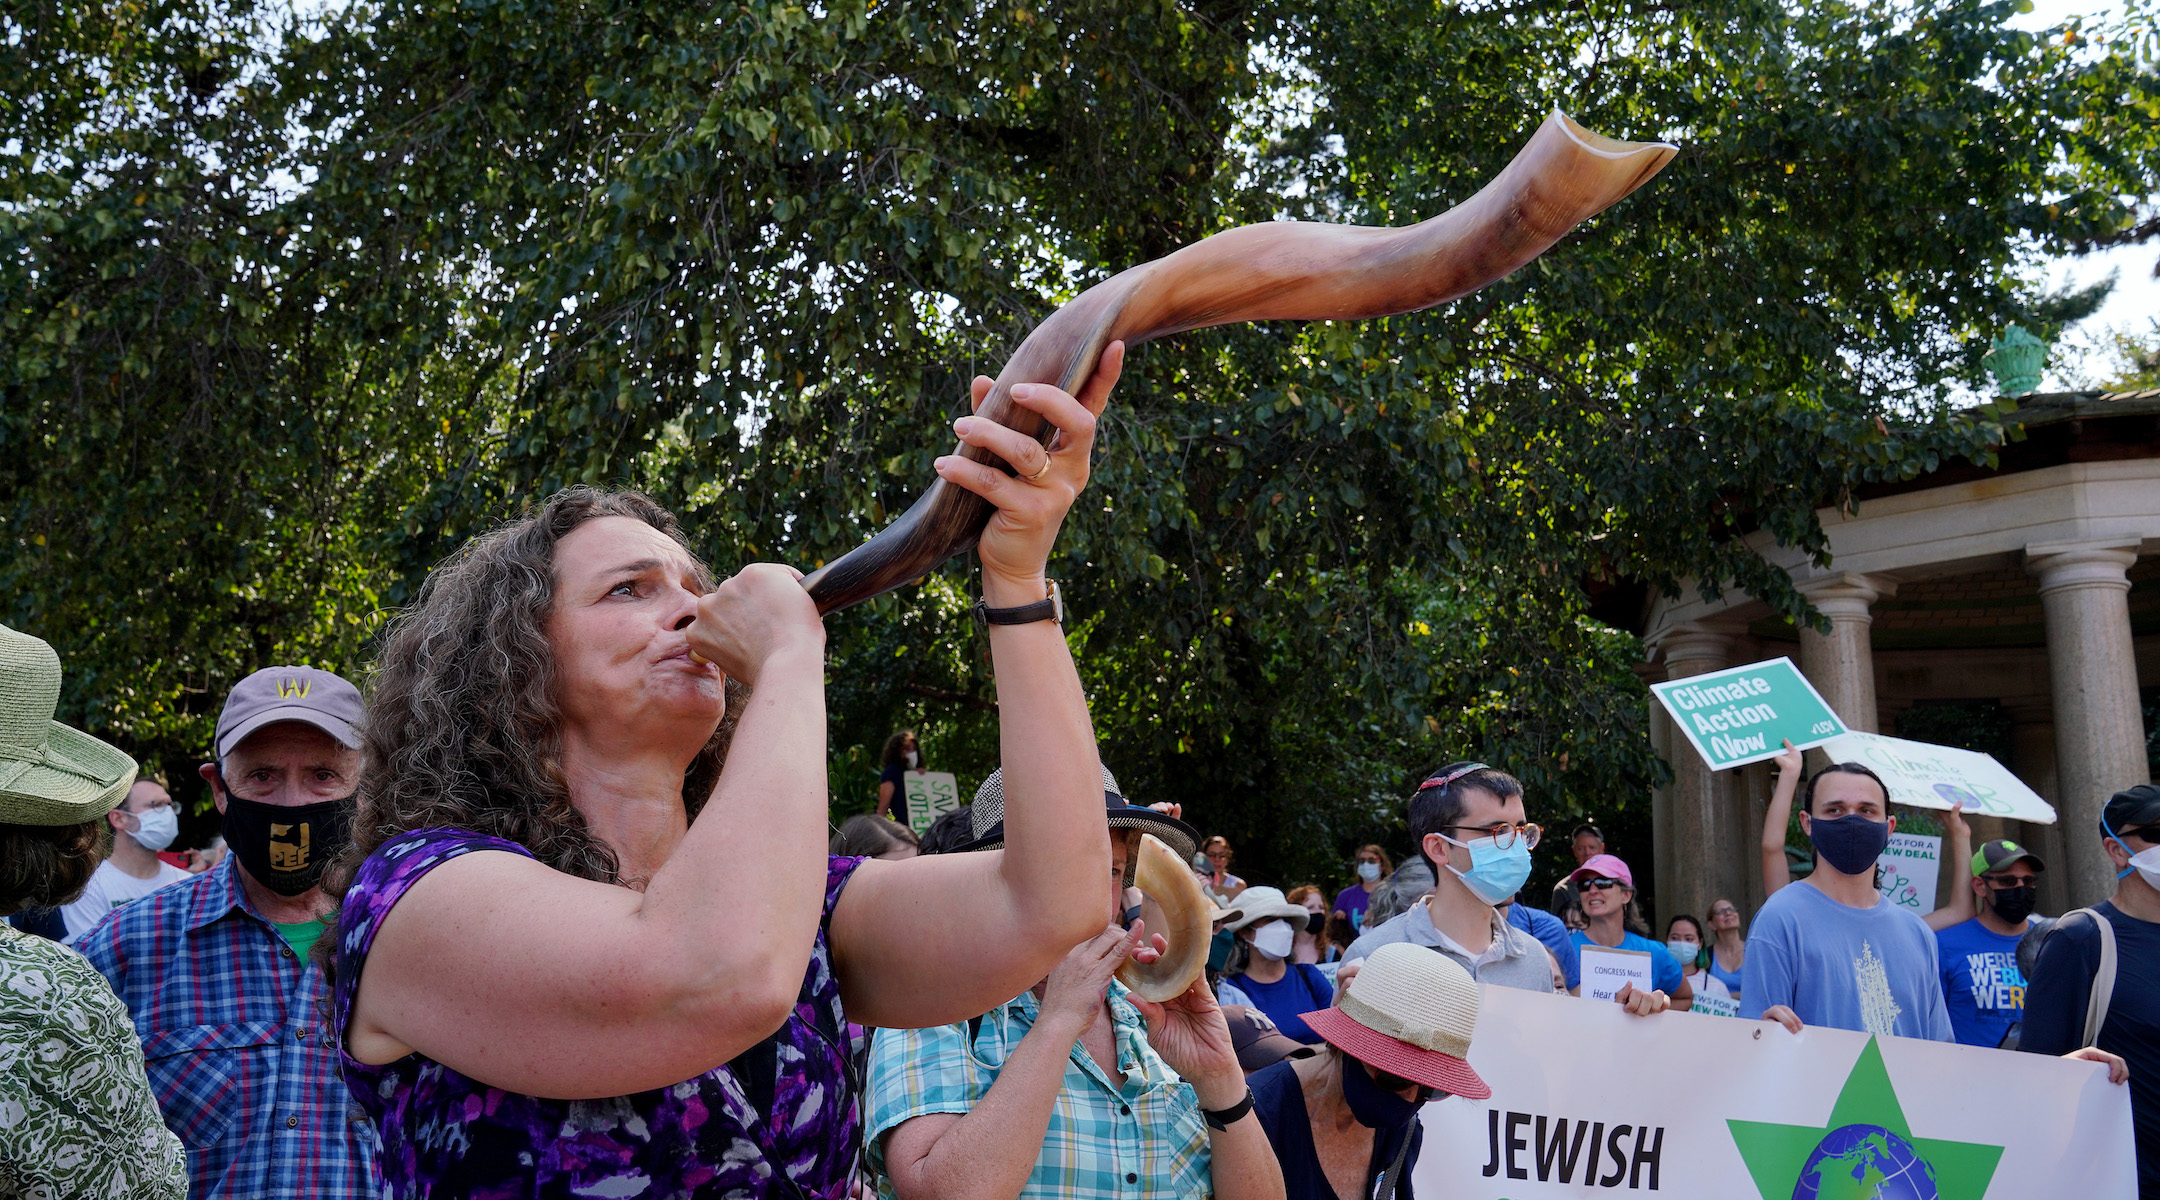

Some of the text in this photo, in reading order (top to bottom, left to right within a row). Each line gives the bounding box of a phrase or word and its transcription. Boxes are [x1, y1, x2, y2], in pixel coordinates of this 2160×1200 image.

[1671, 677, 1771, 711] Climate
[1691, 703, 1778, 735] Action
[1711, 732, 1767, 760] Now
[931, 781, 953, 819] SAV
[1904, 839, 1924, 848] FOR
[271, 849, 310, 867] PEF
[1905, 849, 1936, 860] DEAL
[1966, 952, 2018, 969] WERE
[1594, 966, 1642, 978] CONGRESS Must
[1968, 967, 2028, 987] WEBU
[1592, 989, 1612, 999] Hear
[1693, 994, 1711, 1005] EWS
[1713, 999, 1730, 1009] FOR
[1970, 985, 2027, 1009] WER
[1482, 1109, 1665, 1191] JEWISH
